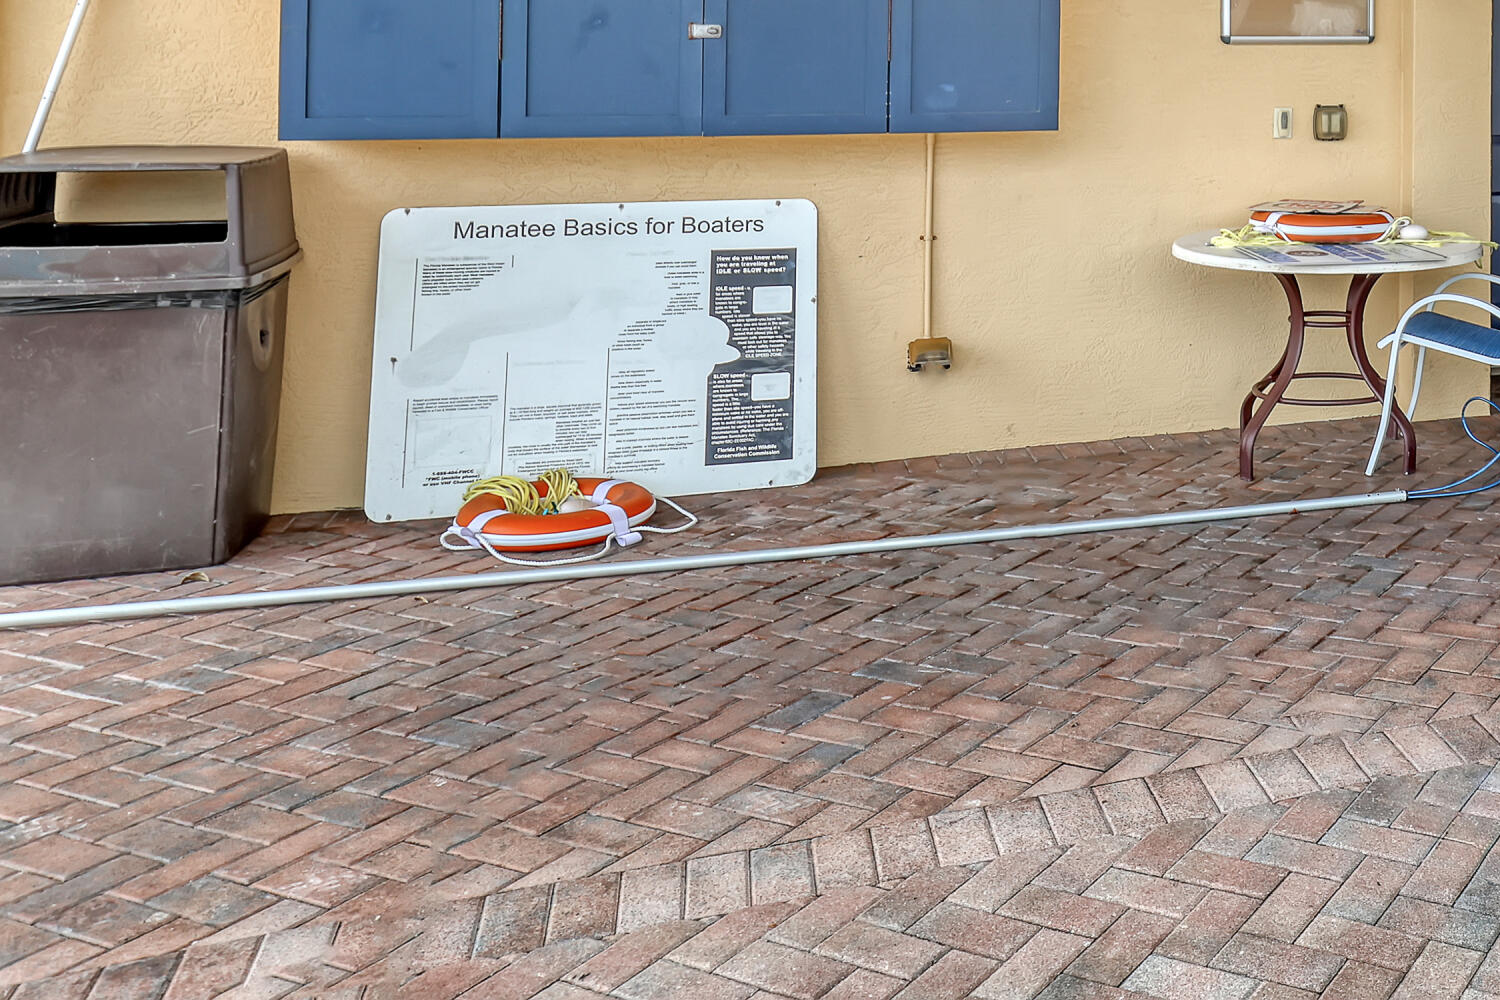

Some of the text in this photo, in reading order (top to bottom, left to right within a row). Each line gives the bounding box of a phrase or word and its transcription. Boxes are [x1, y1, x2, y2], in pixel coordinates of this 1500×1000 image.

[453, 216, 764, 240] Manatee Basics for Boaters
